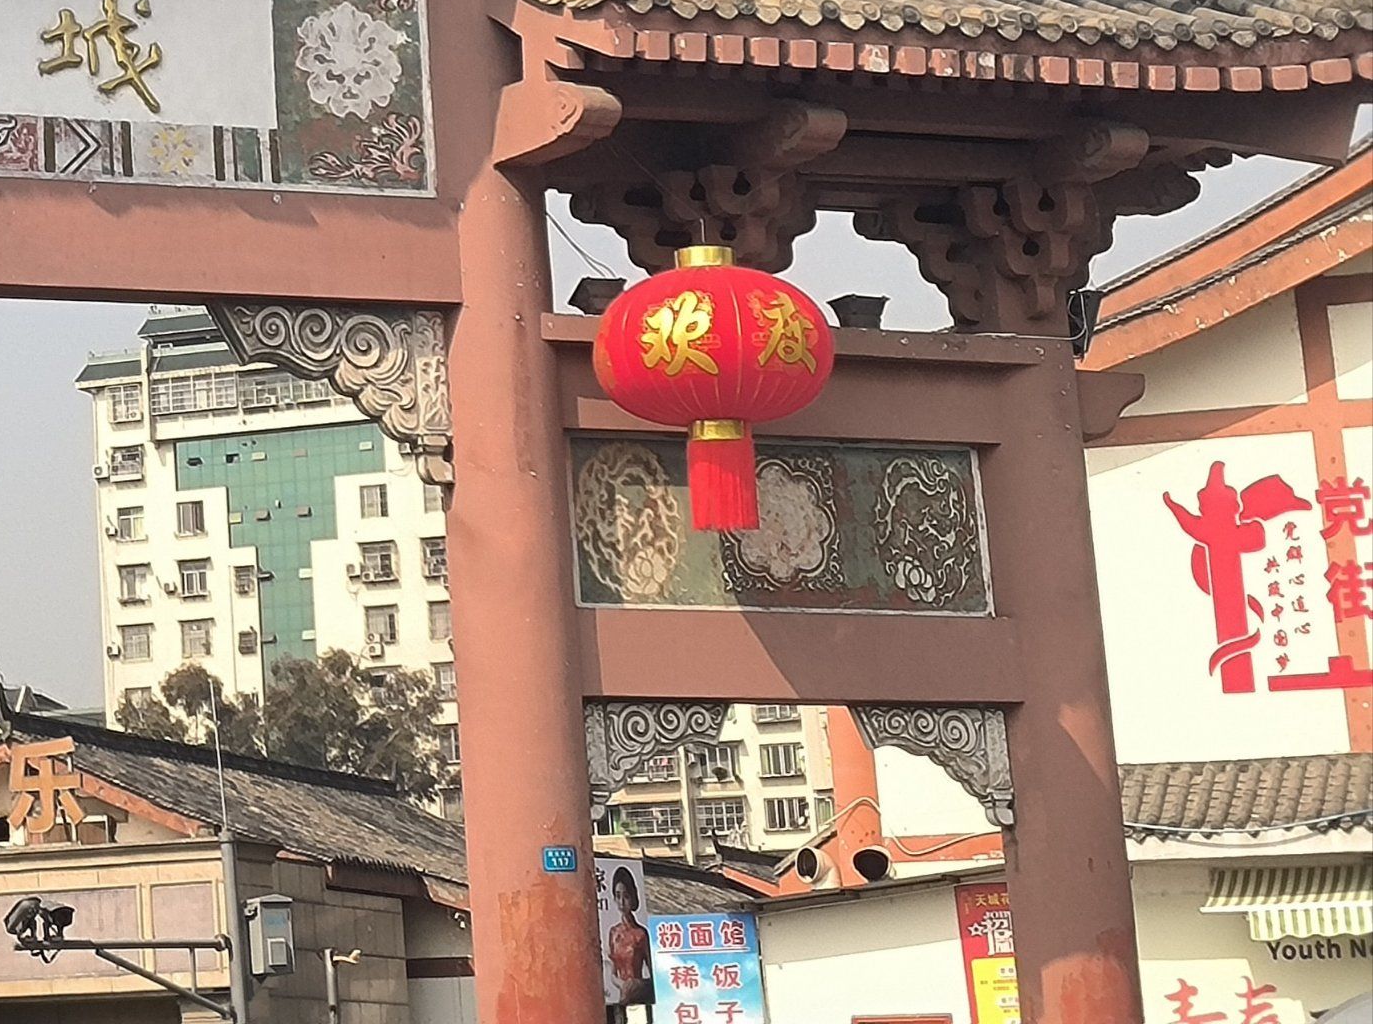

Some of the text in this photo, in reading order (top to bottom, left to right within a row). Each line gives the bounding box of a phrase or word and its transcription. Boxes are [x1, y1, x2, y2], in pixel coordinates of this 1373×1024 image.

[551, 857, 569, 867] 117
[657, 920, 746, 949] 粉面馆
[1266, 938, 1342, 961] Youth
[669, 963, 742, 990] 稀饭
[673, 1001, 744, 1024] 包子
